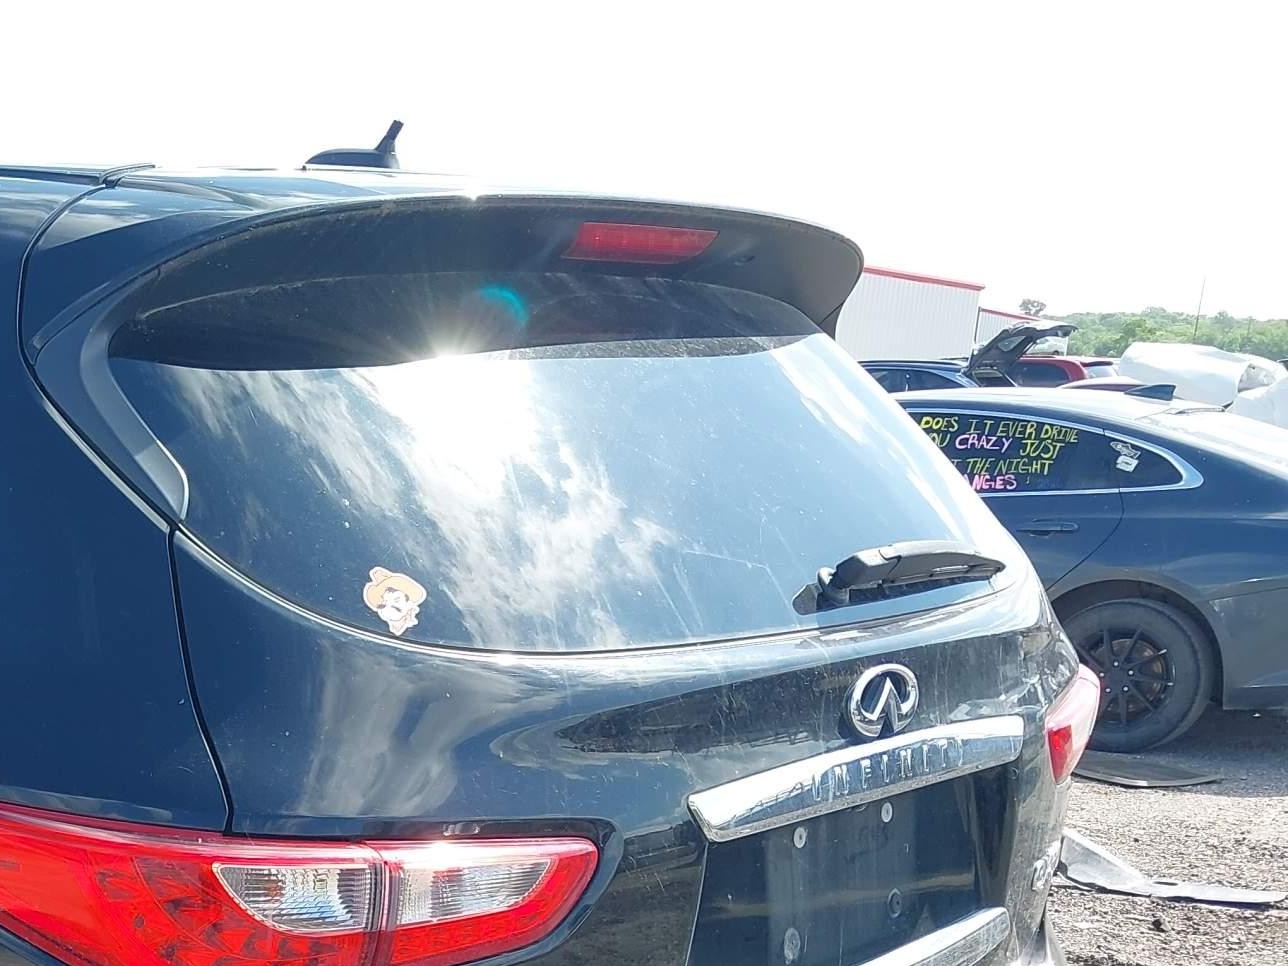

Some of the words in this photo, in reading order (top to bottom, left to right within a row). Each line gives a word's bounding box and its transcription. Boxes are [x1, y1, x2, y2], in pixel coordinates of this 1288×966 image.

[920, 415, 959, 432] DOES
[996, 421, 1037, 441] EVER
[1040, 423, 1079, 443] DRIVE
[955, 433, 1013, 453] CRAZY
[1020, 440, 1064, 458] JUST
[965, 457, 996, 475] THE
[993, 458, 1054, 476] NIGHT
